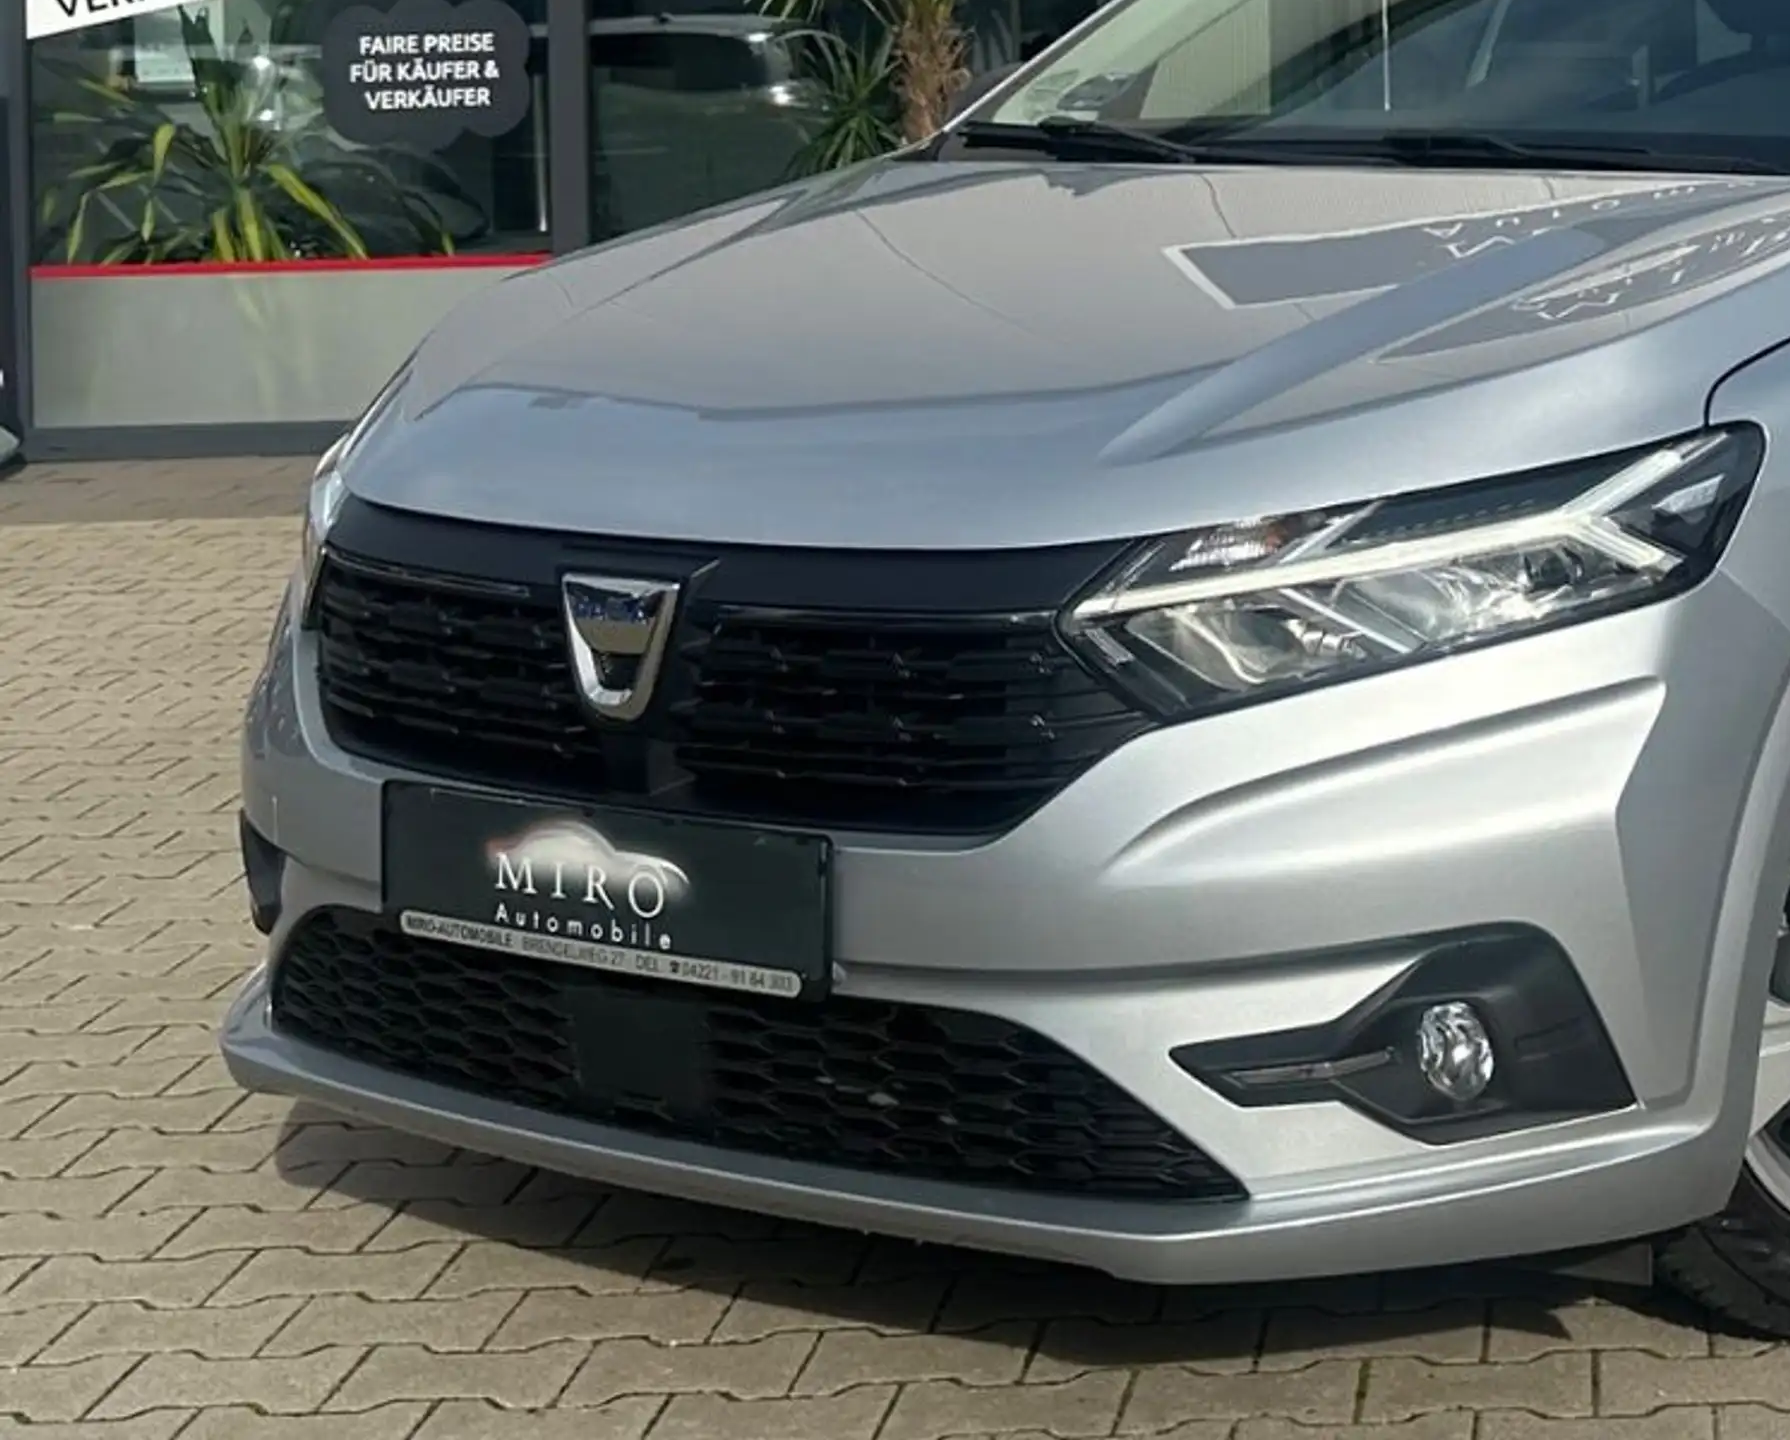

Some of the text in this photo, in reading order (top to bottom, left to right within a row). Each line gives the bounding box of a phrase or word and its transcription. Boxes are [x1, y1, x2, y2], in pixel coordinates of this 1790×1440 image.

[359, 32, 495, 54] FAIRE PREISE
[350, 58, 500, 83] FÜR KÄUFER &
[365, 86, 491, 111] VERKÄUFER
[495, 852, 665, 918] MIRO
[493, 902, 672, 950] Automobile
